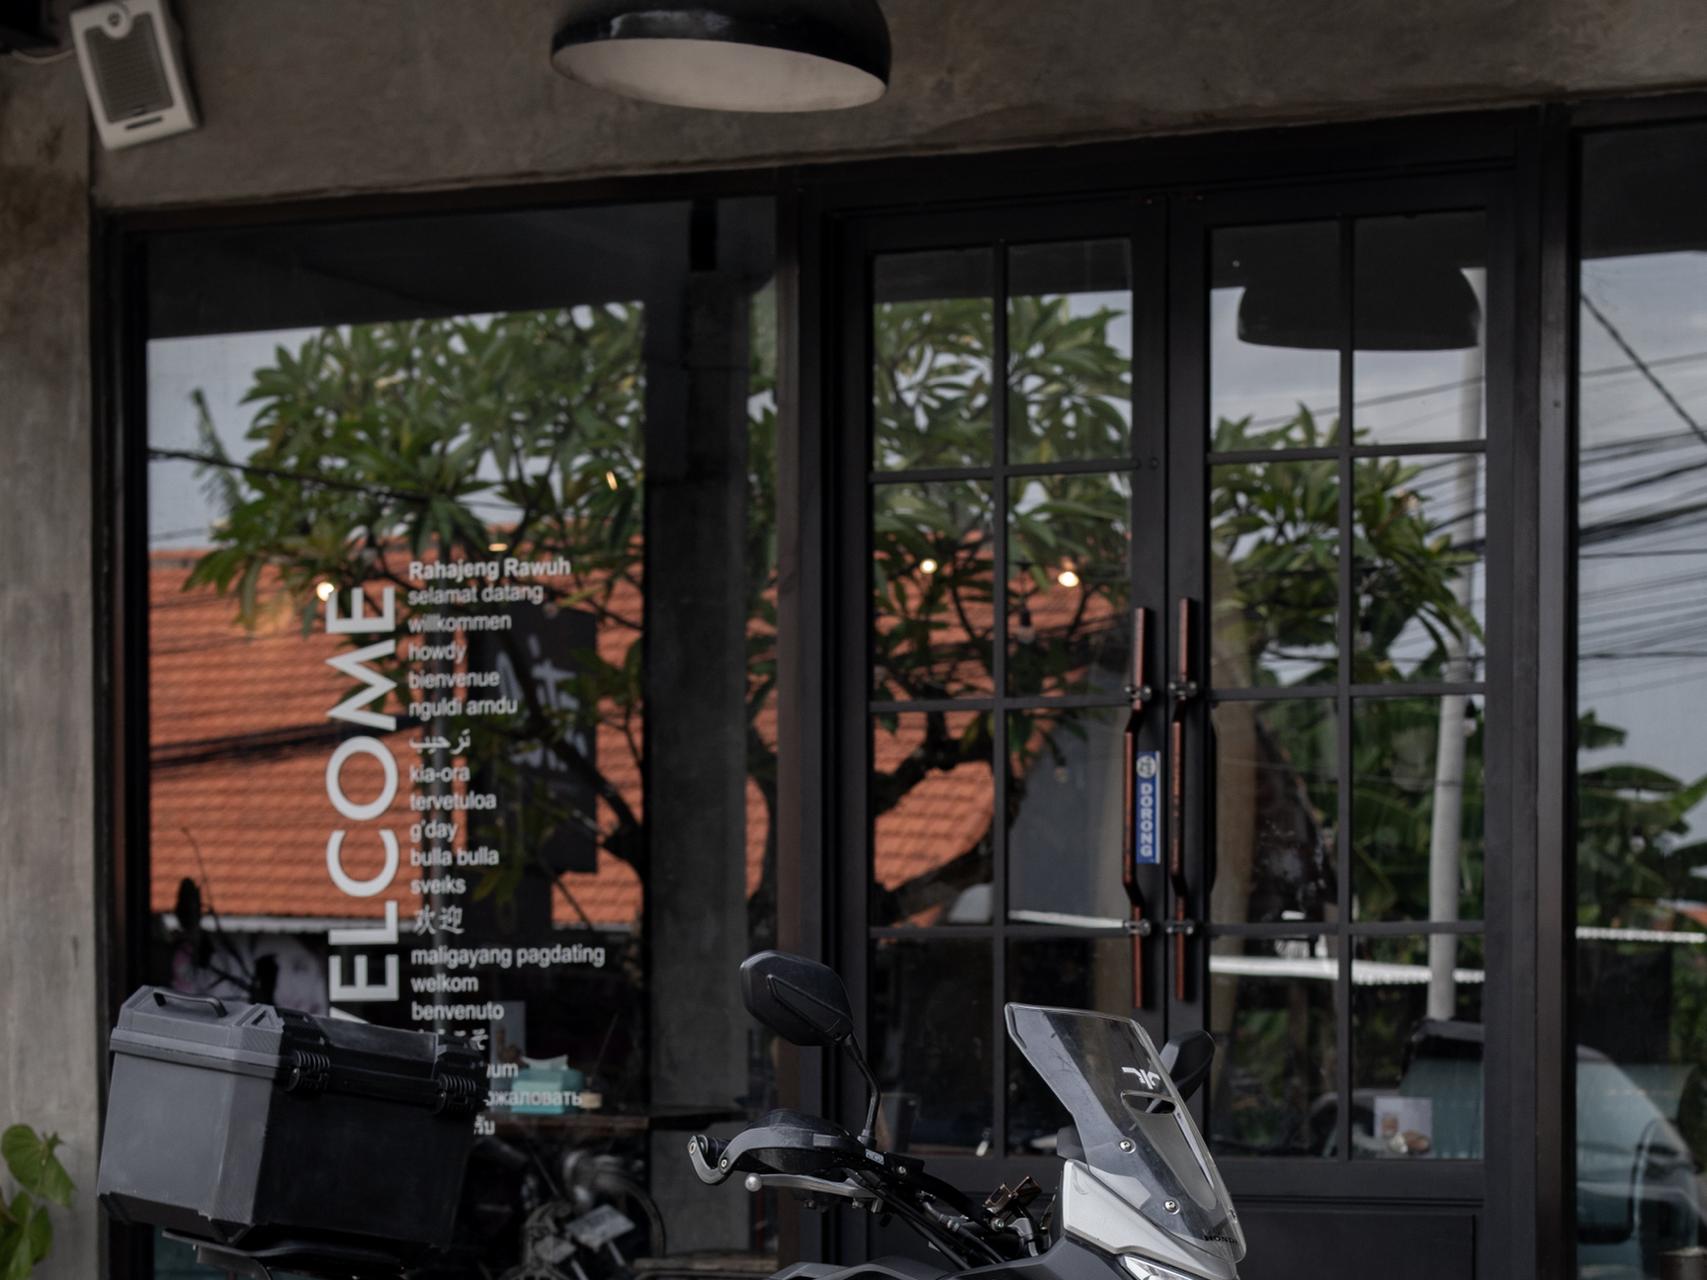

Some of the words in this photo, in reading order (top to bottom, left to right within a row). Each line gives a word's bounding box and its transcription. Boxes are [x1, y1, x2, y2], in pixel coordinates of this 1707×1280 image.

[409, 560, 499, 581] Rahajeng
[504, 556, 571, 577] Rawuh
[408, 586, 477, 605] selamat
[481, 583, 544, 604] datang
[408, 613, 512, 633] willkommen
[408, 642, 467, 663] howdy
[408, 670, 500, 690] bienvenue
[409, 763, 470, 783] kia-ora
[326, 587, 399, 1024] ELCOME
[409, 792, 497, 811] tervetuloa
[1140, 783, 1153, 857] DORONG
[410, 821, 458, 842] g'day
[410, 848, 452, 867] bulla
[456, 846, 499, 866] bulla
[410, 877, 466, 896] sveiks
[413, 904, 464, 935] 欢迎
[411, 947, 512, 969] maligayang
[517, 943, 605, 968] pagdating
[411, 974, 479, 993] welkom
[411, 1001, 505, 1021] benvenuto
